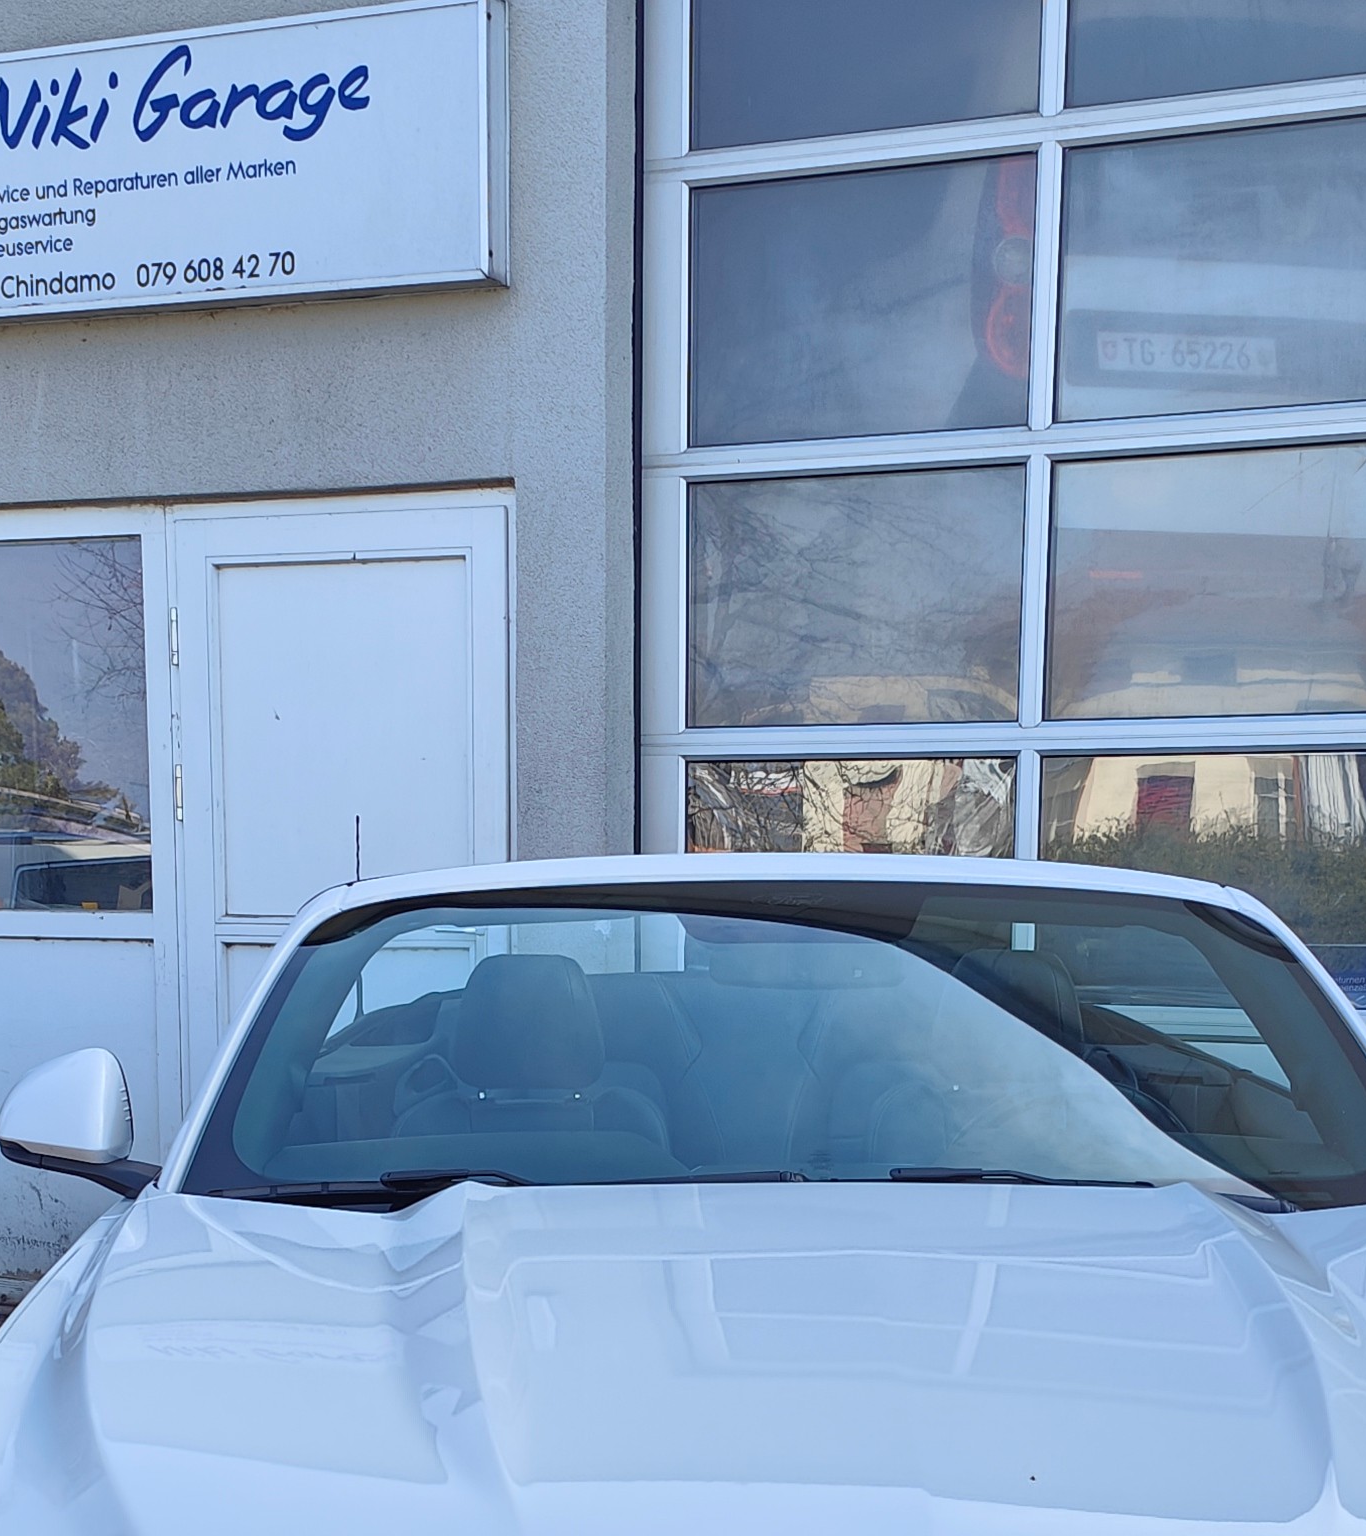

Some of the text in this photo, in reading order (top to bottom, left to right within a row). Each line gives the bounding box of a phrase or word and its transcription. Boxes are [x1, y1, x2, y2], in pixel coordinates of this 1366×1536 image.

[133, 45, 370, 142] Garage
[35, 179, 69, 200] und
[72, 171, 179, 199] Reparaturen
[184, 165, 222, 185] aller
[226, 158, 297, 181] Marken
[0, 271, 116, 299] Chindamo
[136, 261, 177, 288] 079
[183, 256, 224, 283] 608
[232, 253, 260, 280] 42
[268, 251, 295, 276] 70
[1122, 338, 1156, 367] TG
